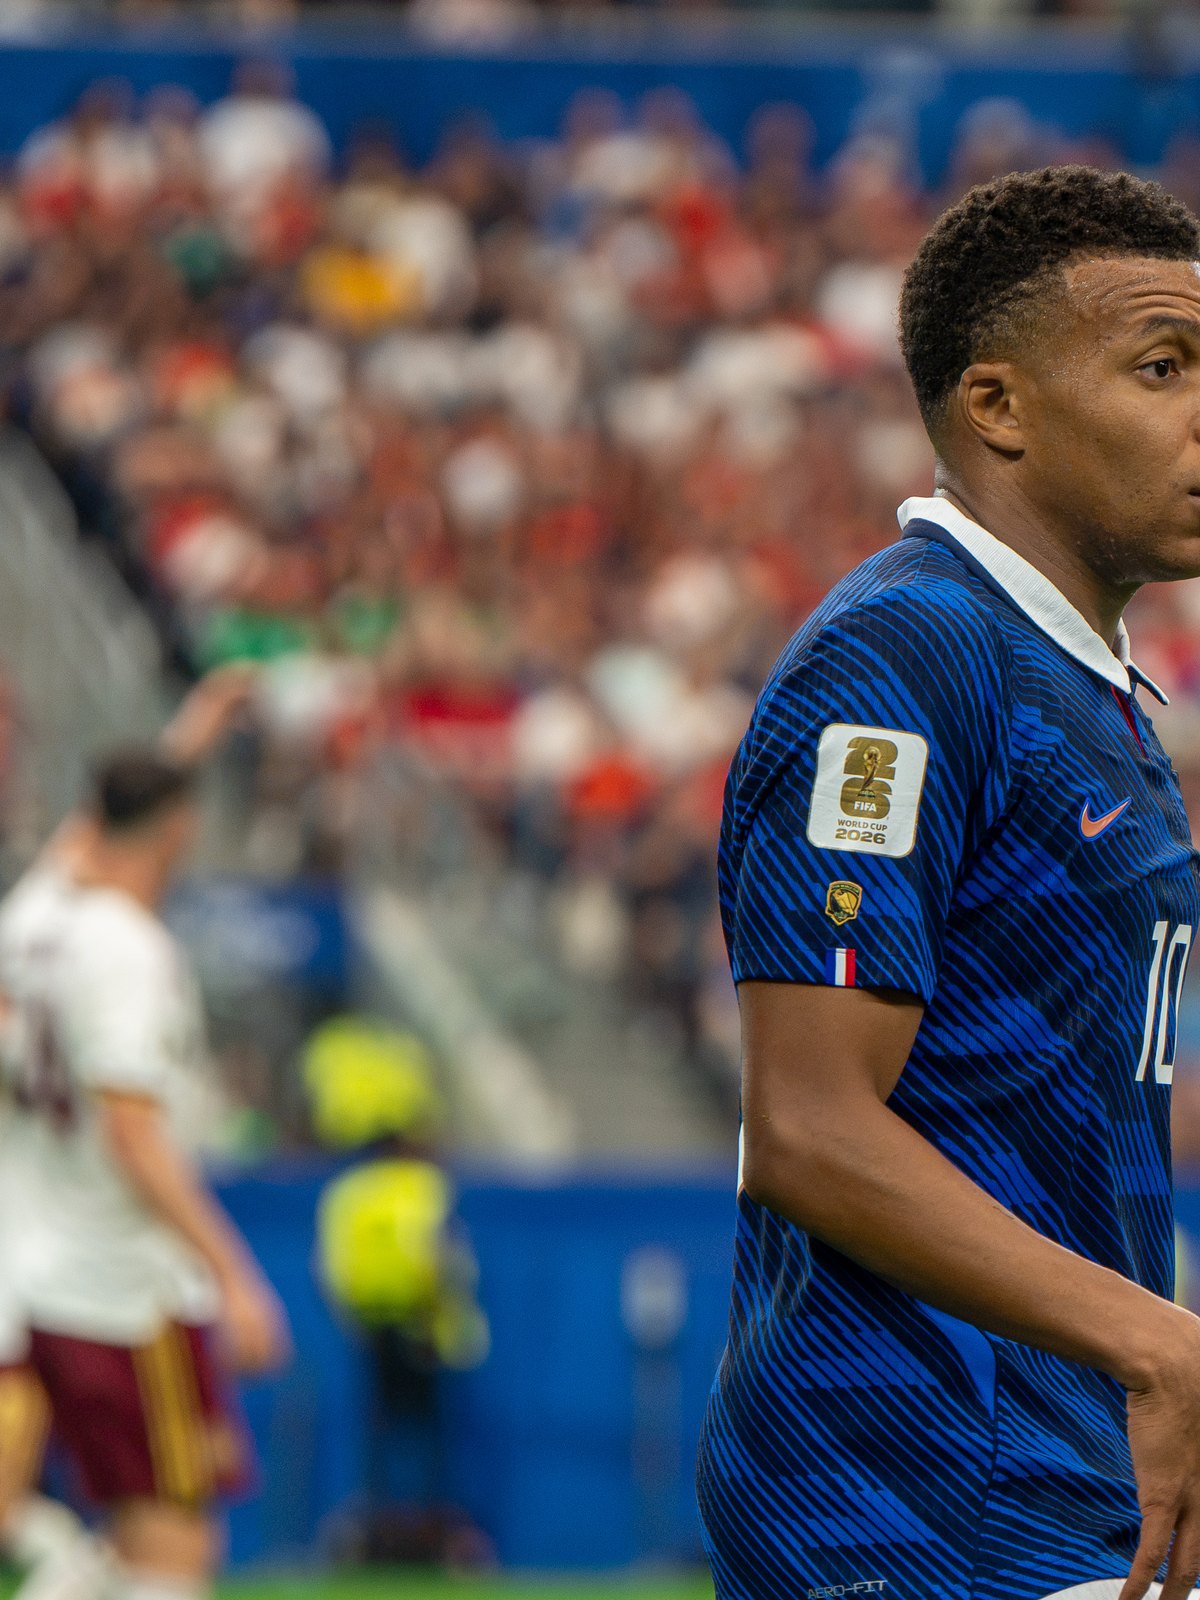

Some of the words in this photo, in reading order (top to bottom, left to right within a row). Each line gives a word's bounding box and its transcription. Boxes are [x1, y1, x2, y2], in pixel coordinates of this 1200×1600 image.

[854, 801, 877, 812] FIFA
[837, 819, 869, 829] WORLD
[870, 823, 888, 831] CUP
[835, 828, 886, 844] 2026
[1135, 920, 1192, 1085] 10
[808, 1580, 888, 1599] AERO-FIT
